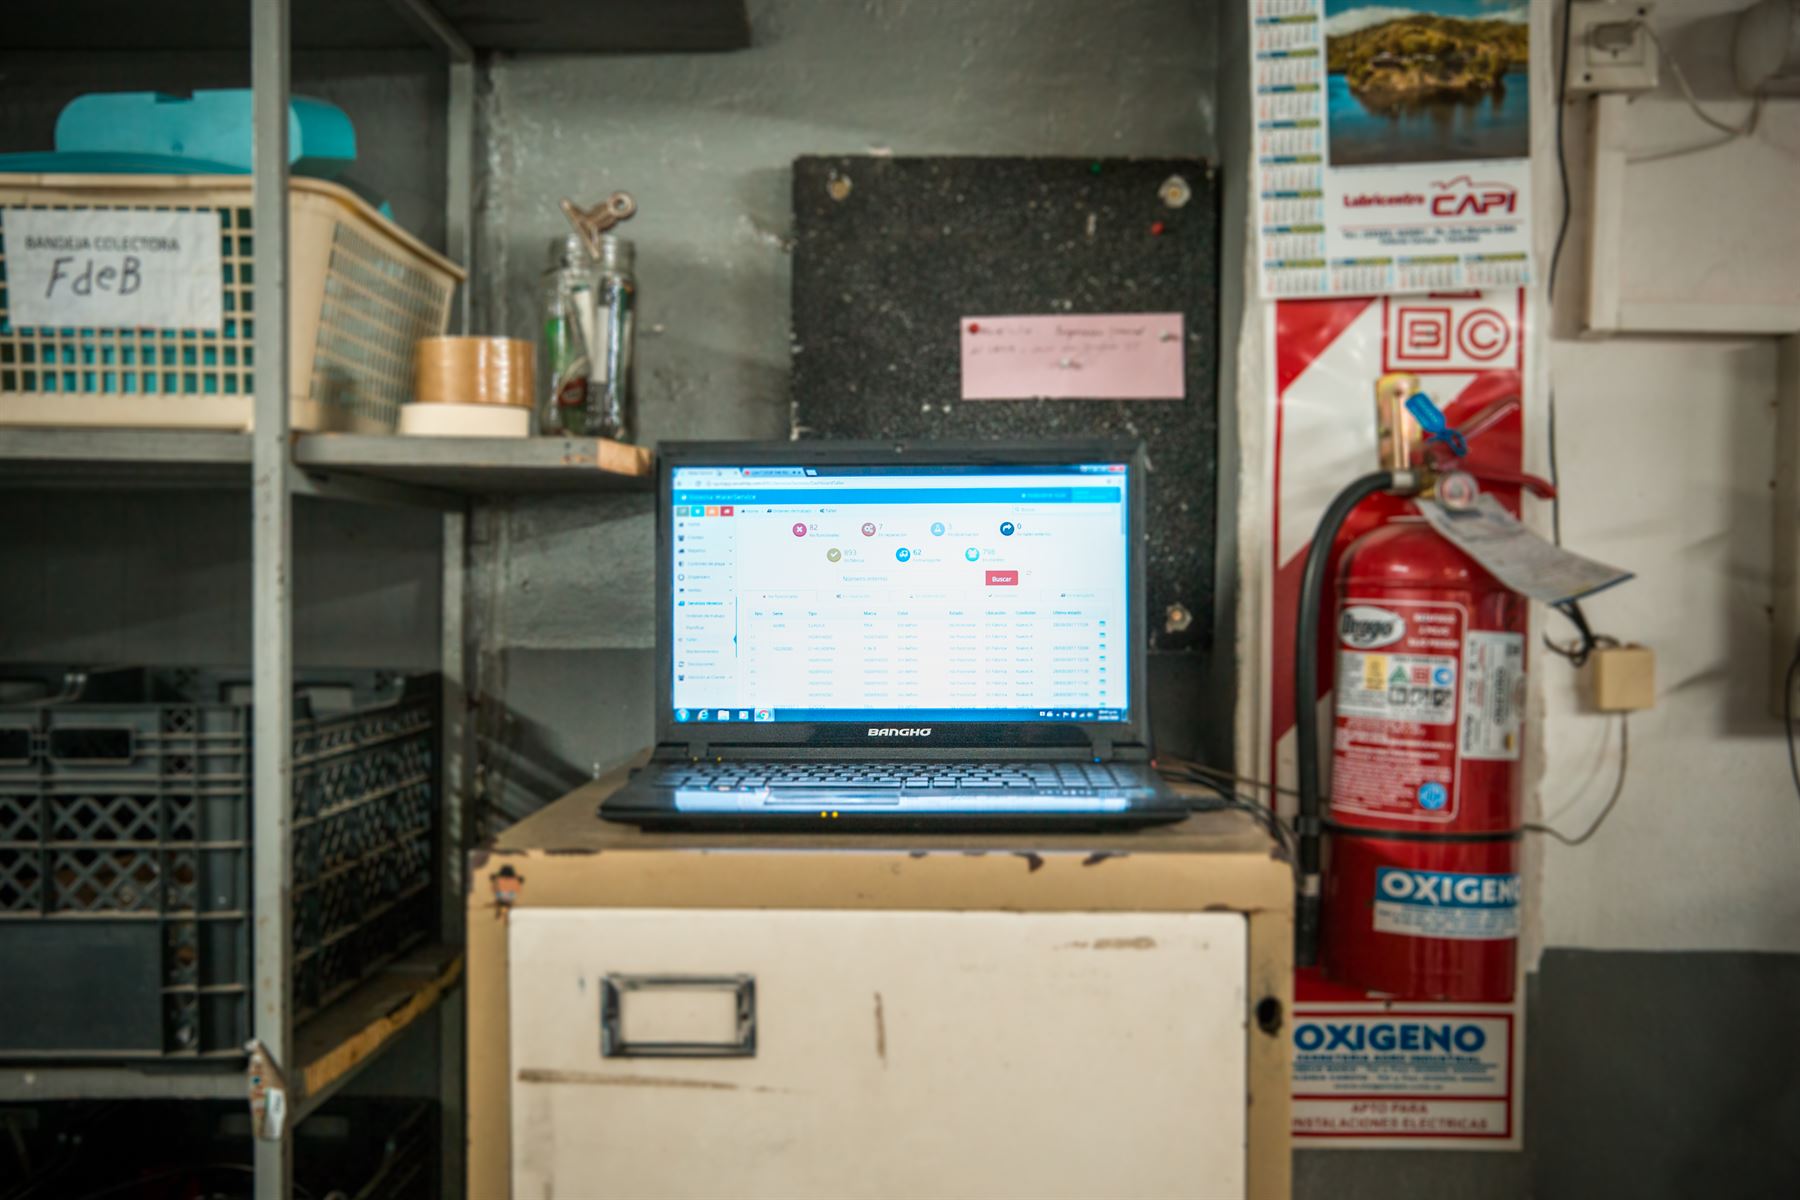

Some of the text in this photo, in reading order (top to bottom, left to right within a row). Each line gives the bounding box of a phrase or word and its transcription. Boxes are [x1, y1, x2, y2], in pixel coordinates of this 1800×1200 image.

[1431, 190, 1518, 216] CAPI
[25, 235, 181, 252] BANDEJA COLECTORA
[991, 575, 1013, 584] Buscar
[1381, 871, 1520, 904] OXIGEN
[1293, 1023, 1486, 1052] OXIGENO
[1351, 1102, 1428, 1114] APTO PARA
[1291, 1116, 1489, 1130] NSTALACIONES ELECTRICAS
